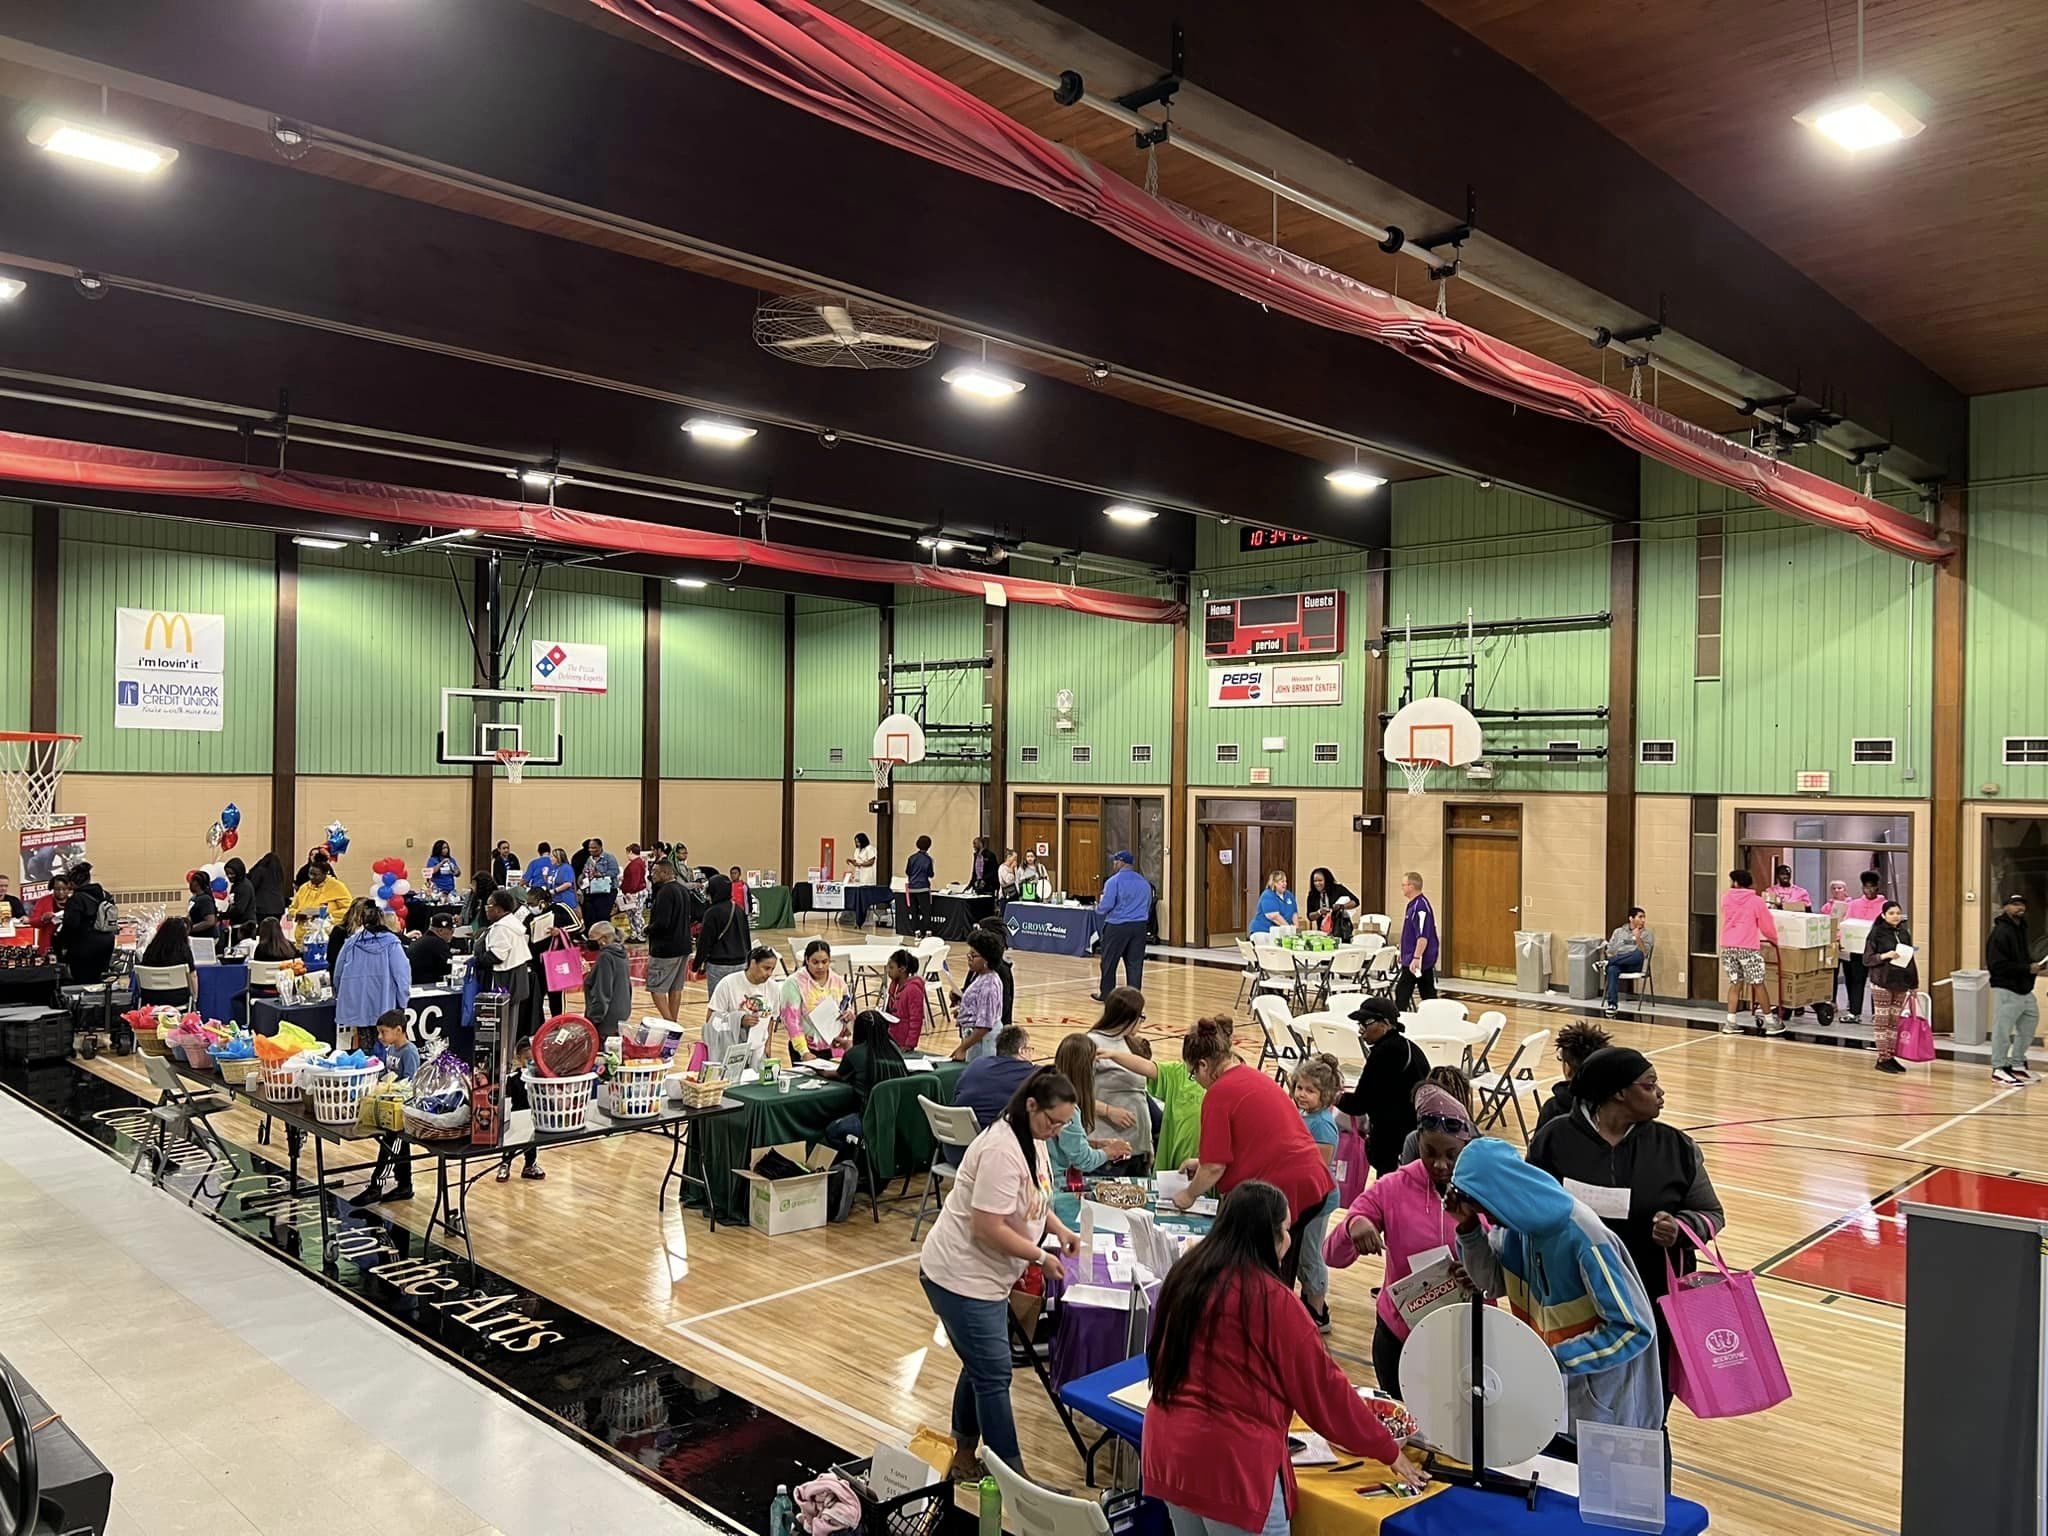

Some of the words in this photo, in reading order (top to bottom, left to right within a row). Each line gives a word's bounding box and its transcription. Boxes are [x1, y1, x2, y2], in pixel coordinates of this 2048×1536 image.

[1305, 595, 1334, 608] Guests
[1210, 604, 1231, 616] Home
[1256, 638, 1280, 652] period
[138, 657, 156, 667] i'm
[158, 657, 189, 669] lovin'
[190, 659, 199, 669] it
[1222, 672, 1262, 685] PEPSI
[143, 684, 218, 697] LANDMARK
[1275, 685, 1290, 693] JOHN
[1292, 684, 1313, 692] BRYANT
[1315, 683, 1337, 692] CENTER
[143, 695, 179, 705] CREDIT
[183, 696, 218, 707] UNION
[310, 1226, 399, 1261] for
[369, 1257, 460, 1296] the
[429, 1294, 565, 1352] Arts
[1408, 1280, 1455, 1311] MONOPOLY
